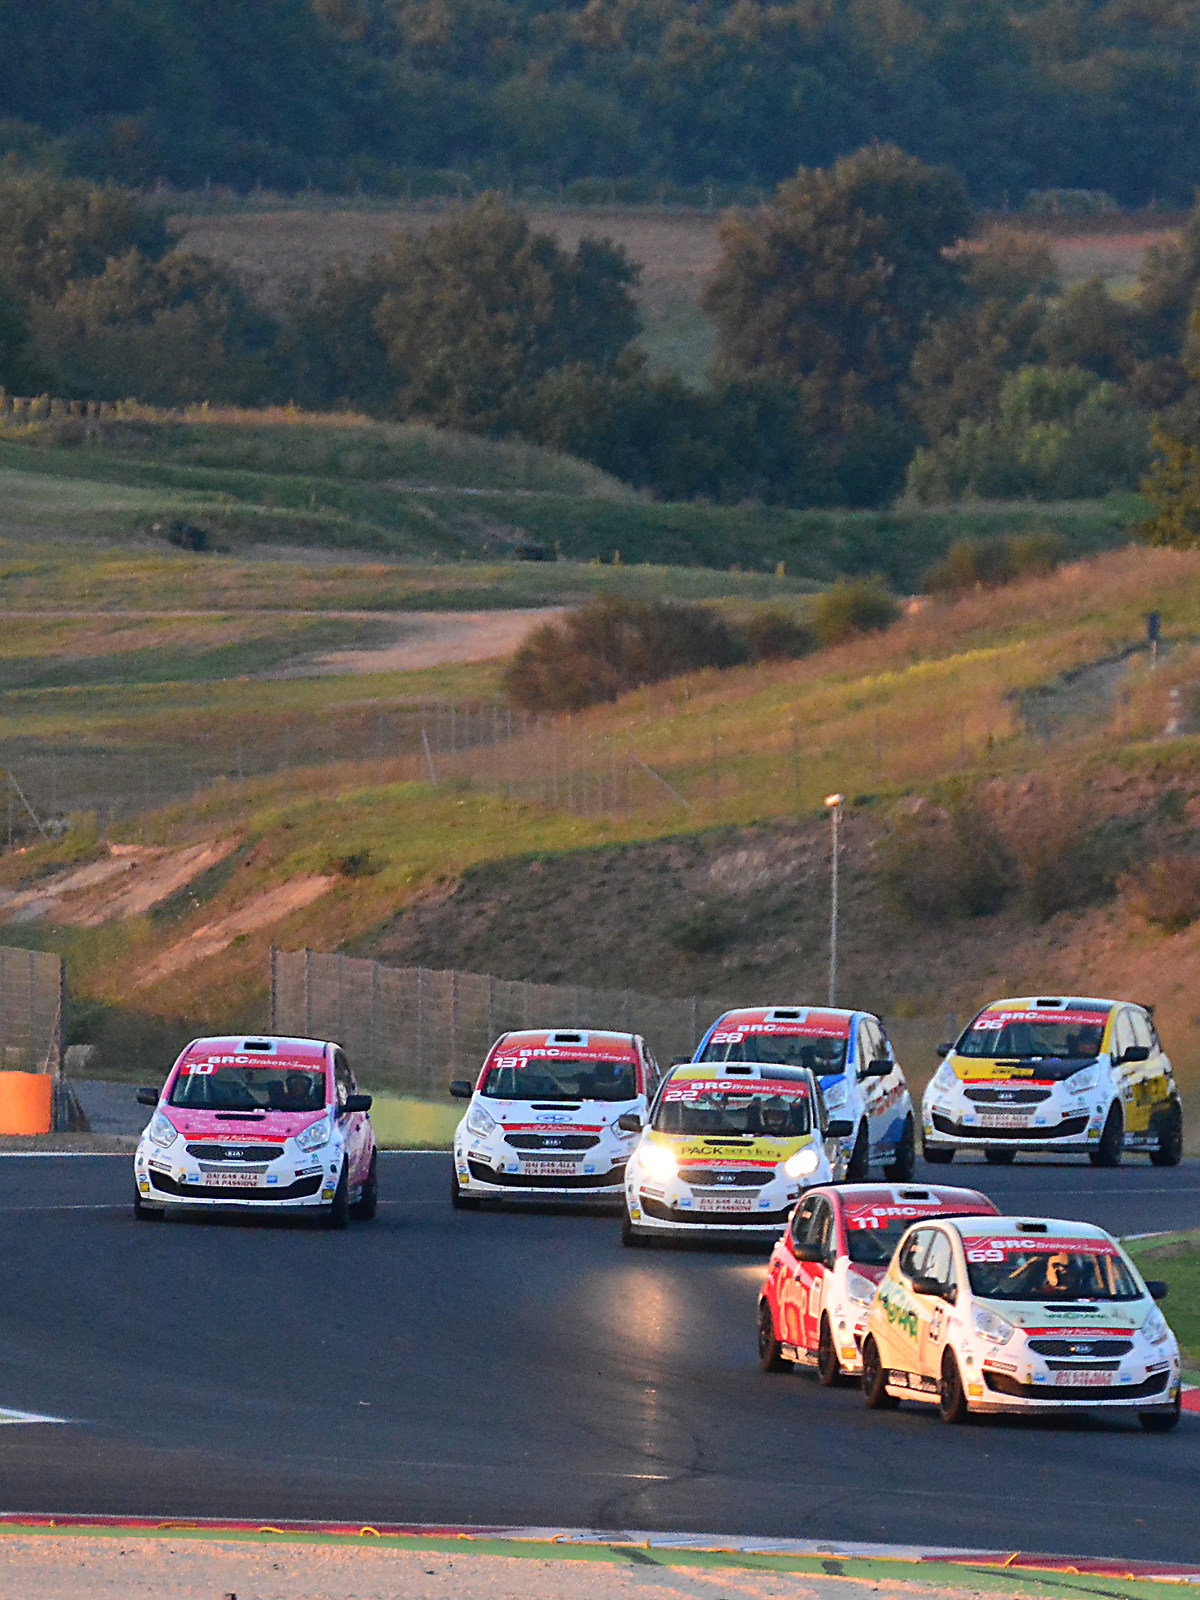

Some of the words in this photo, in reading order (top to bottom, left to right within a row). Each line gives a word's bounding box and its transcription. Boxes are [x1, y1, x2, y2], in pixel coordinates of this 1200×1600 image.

[1000, 1012, 1038, 1020] BRC
[737, 1024, 777, 1032] BRC
[711, 1032, 744, 1044] 28
[520, 1049, 560, 1057] BRC
[208, 1056, 249, 1064] BRC
[494, 1057, 528, 1068] 131
[185, 1064, 214, 1075] 10
[691, 1081, 733, 1090] BRC
[665, 1090, 699, 1102] 22
[872, 1207, 917, 1217] BRC
[990, 1240, 1036, 1249] BRC
[967, 1249, 1004, 1262] 69
